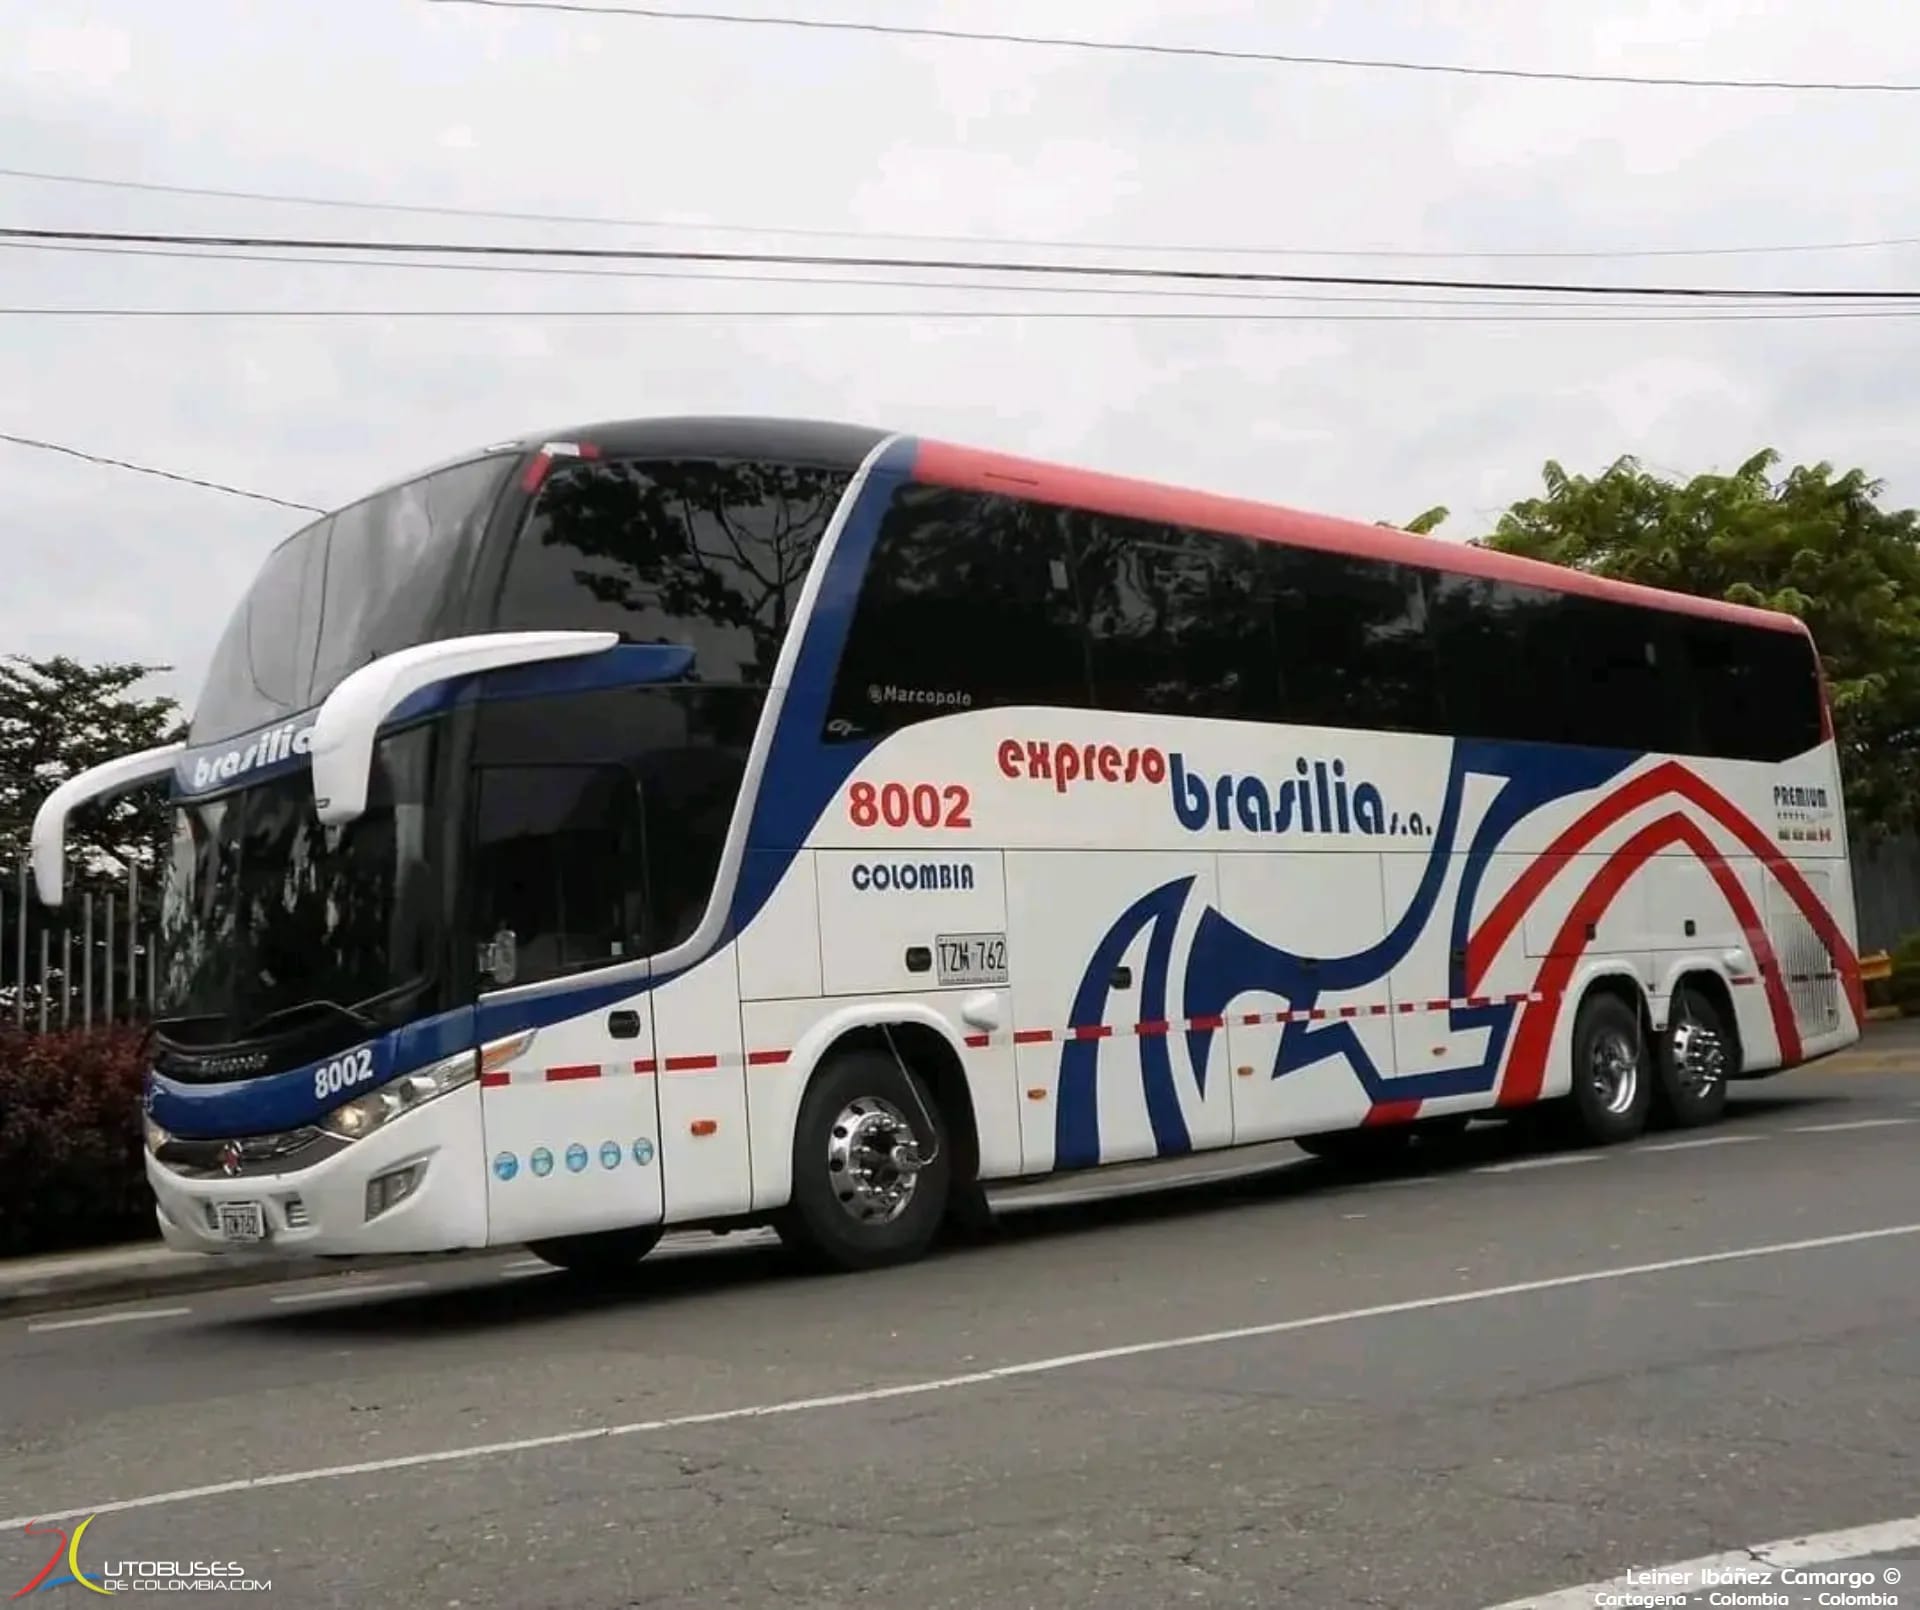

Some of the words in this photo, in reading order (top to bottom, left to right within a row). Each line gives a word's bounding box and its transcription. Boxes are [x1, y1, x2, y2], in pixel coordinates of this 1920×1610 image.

[883, 685, 972, 706] Marcopolo
[849, 780, 972, 828] 8002
[998, 739, 1165, 793] expreso
[1168, 752, 1385, 835] brasilia
[1389, 811, 1432, 836] s.a.
[1773, 785, 1828, 808] PREMIUM
[852, 864, 974, 890] COLOMBIA
[315, 1048, 373, 1099] 8002
